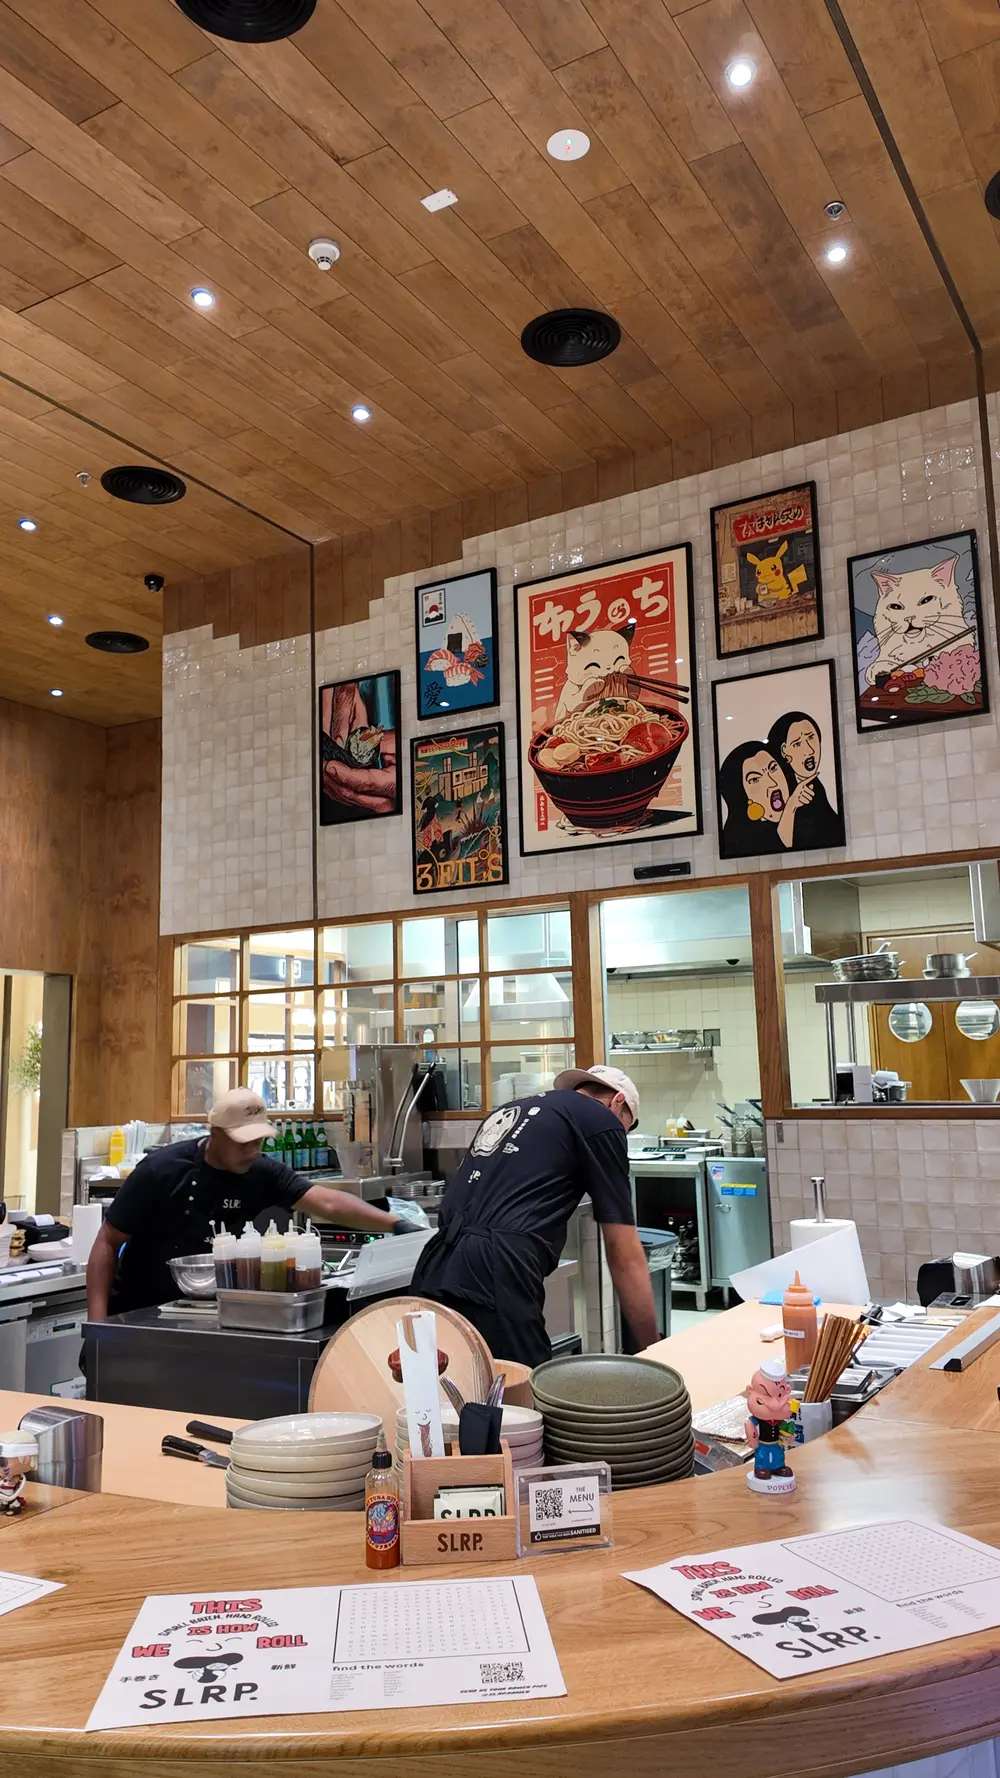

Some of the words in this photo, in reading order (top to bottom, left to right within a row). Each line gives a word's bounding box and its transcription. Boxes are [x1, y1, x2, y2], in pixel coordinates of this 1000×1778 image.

[569, 1493, 595, 1503] MENU
[570, 1527, 596, 1536] SANITISED
[437, 1533, 483, 1552] SLRP.
[671, 1561, 742, 1580] THIS
[748, 1575, 784, 1584] ROLLED
[708, 1589, 737, 1599] IS
[731, 1581, 774, 1595] HOW
[785, 1584, 839, 1601] ROLL
[190, 1598, 263, 1615] THIS
[691, 1606, 736, 1621] WE
[186, 1625, 212, 1636] IS
[216, 1623, 259, 1635] HOW
[256, 1635, 308, 1649] ROLL
[775, 1626, 882, 1659] SLRP.
[132, 1644, 171, 1658] WE
[139, 1682, 259, 1710] SLRP.
